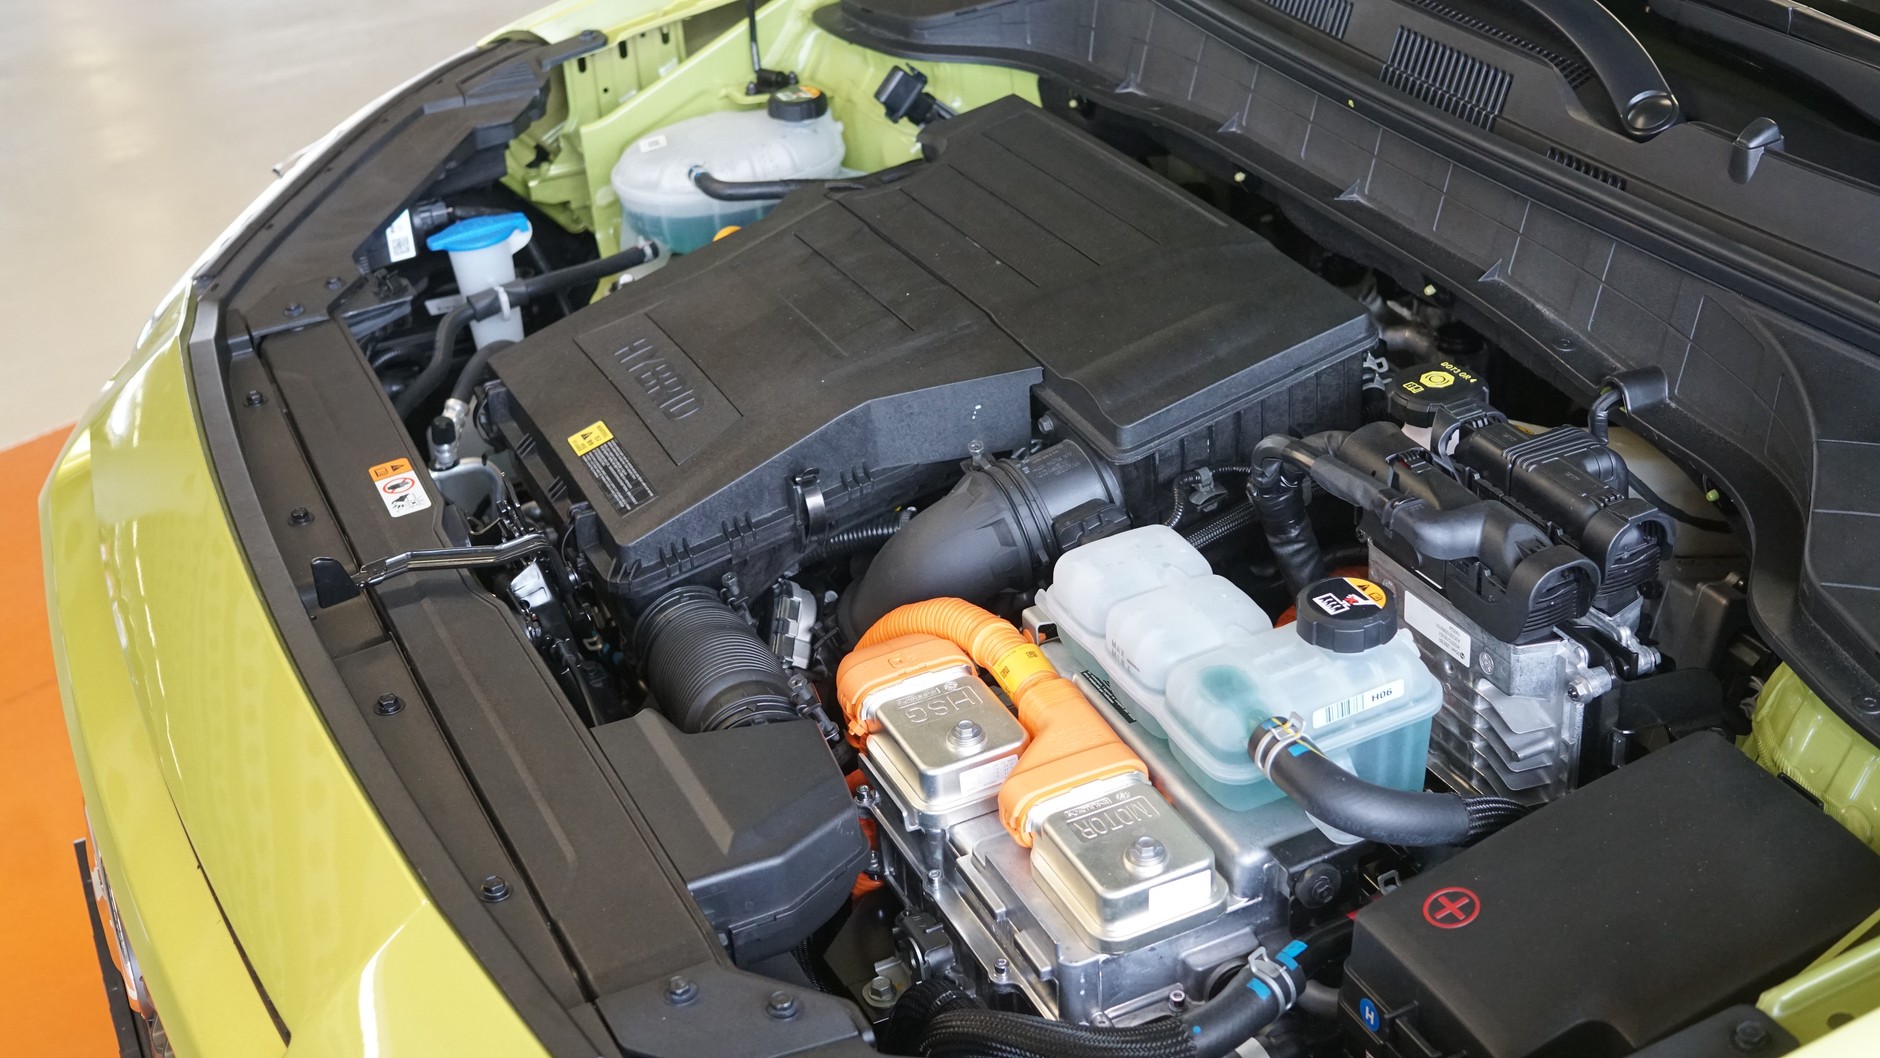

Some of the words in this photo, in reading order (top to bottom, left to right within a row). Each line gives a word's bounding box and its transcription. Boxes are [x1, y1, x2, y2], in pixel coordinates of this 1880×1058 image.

[614, 338, 700, 420] HYBRID
[1440, 361, 1461, 374] DOT3
[1459, 372, 1471, 380] OR
[1111, 639, 1125, 657] MAX
[1371, 687, 1393, 702] H06
[905, 691, 976, 723] HSG
[1073, 800, 1153, 839] MOTOR
[1365, 1006, 1375, 1025] H
